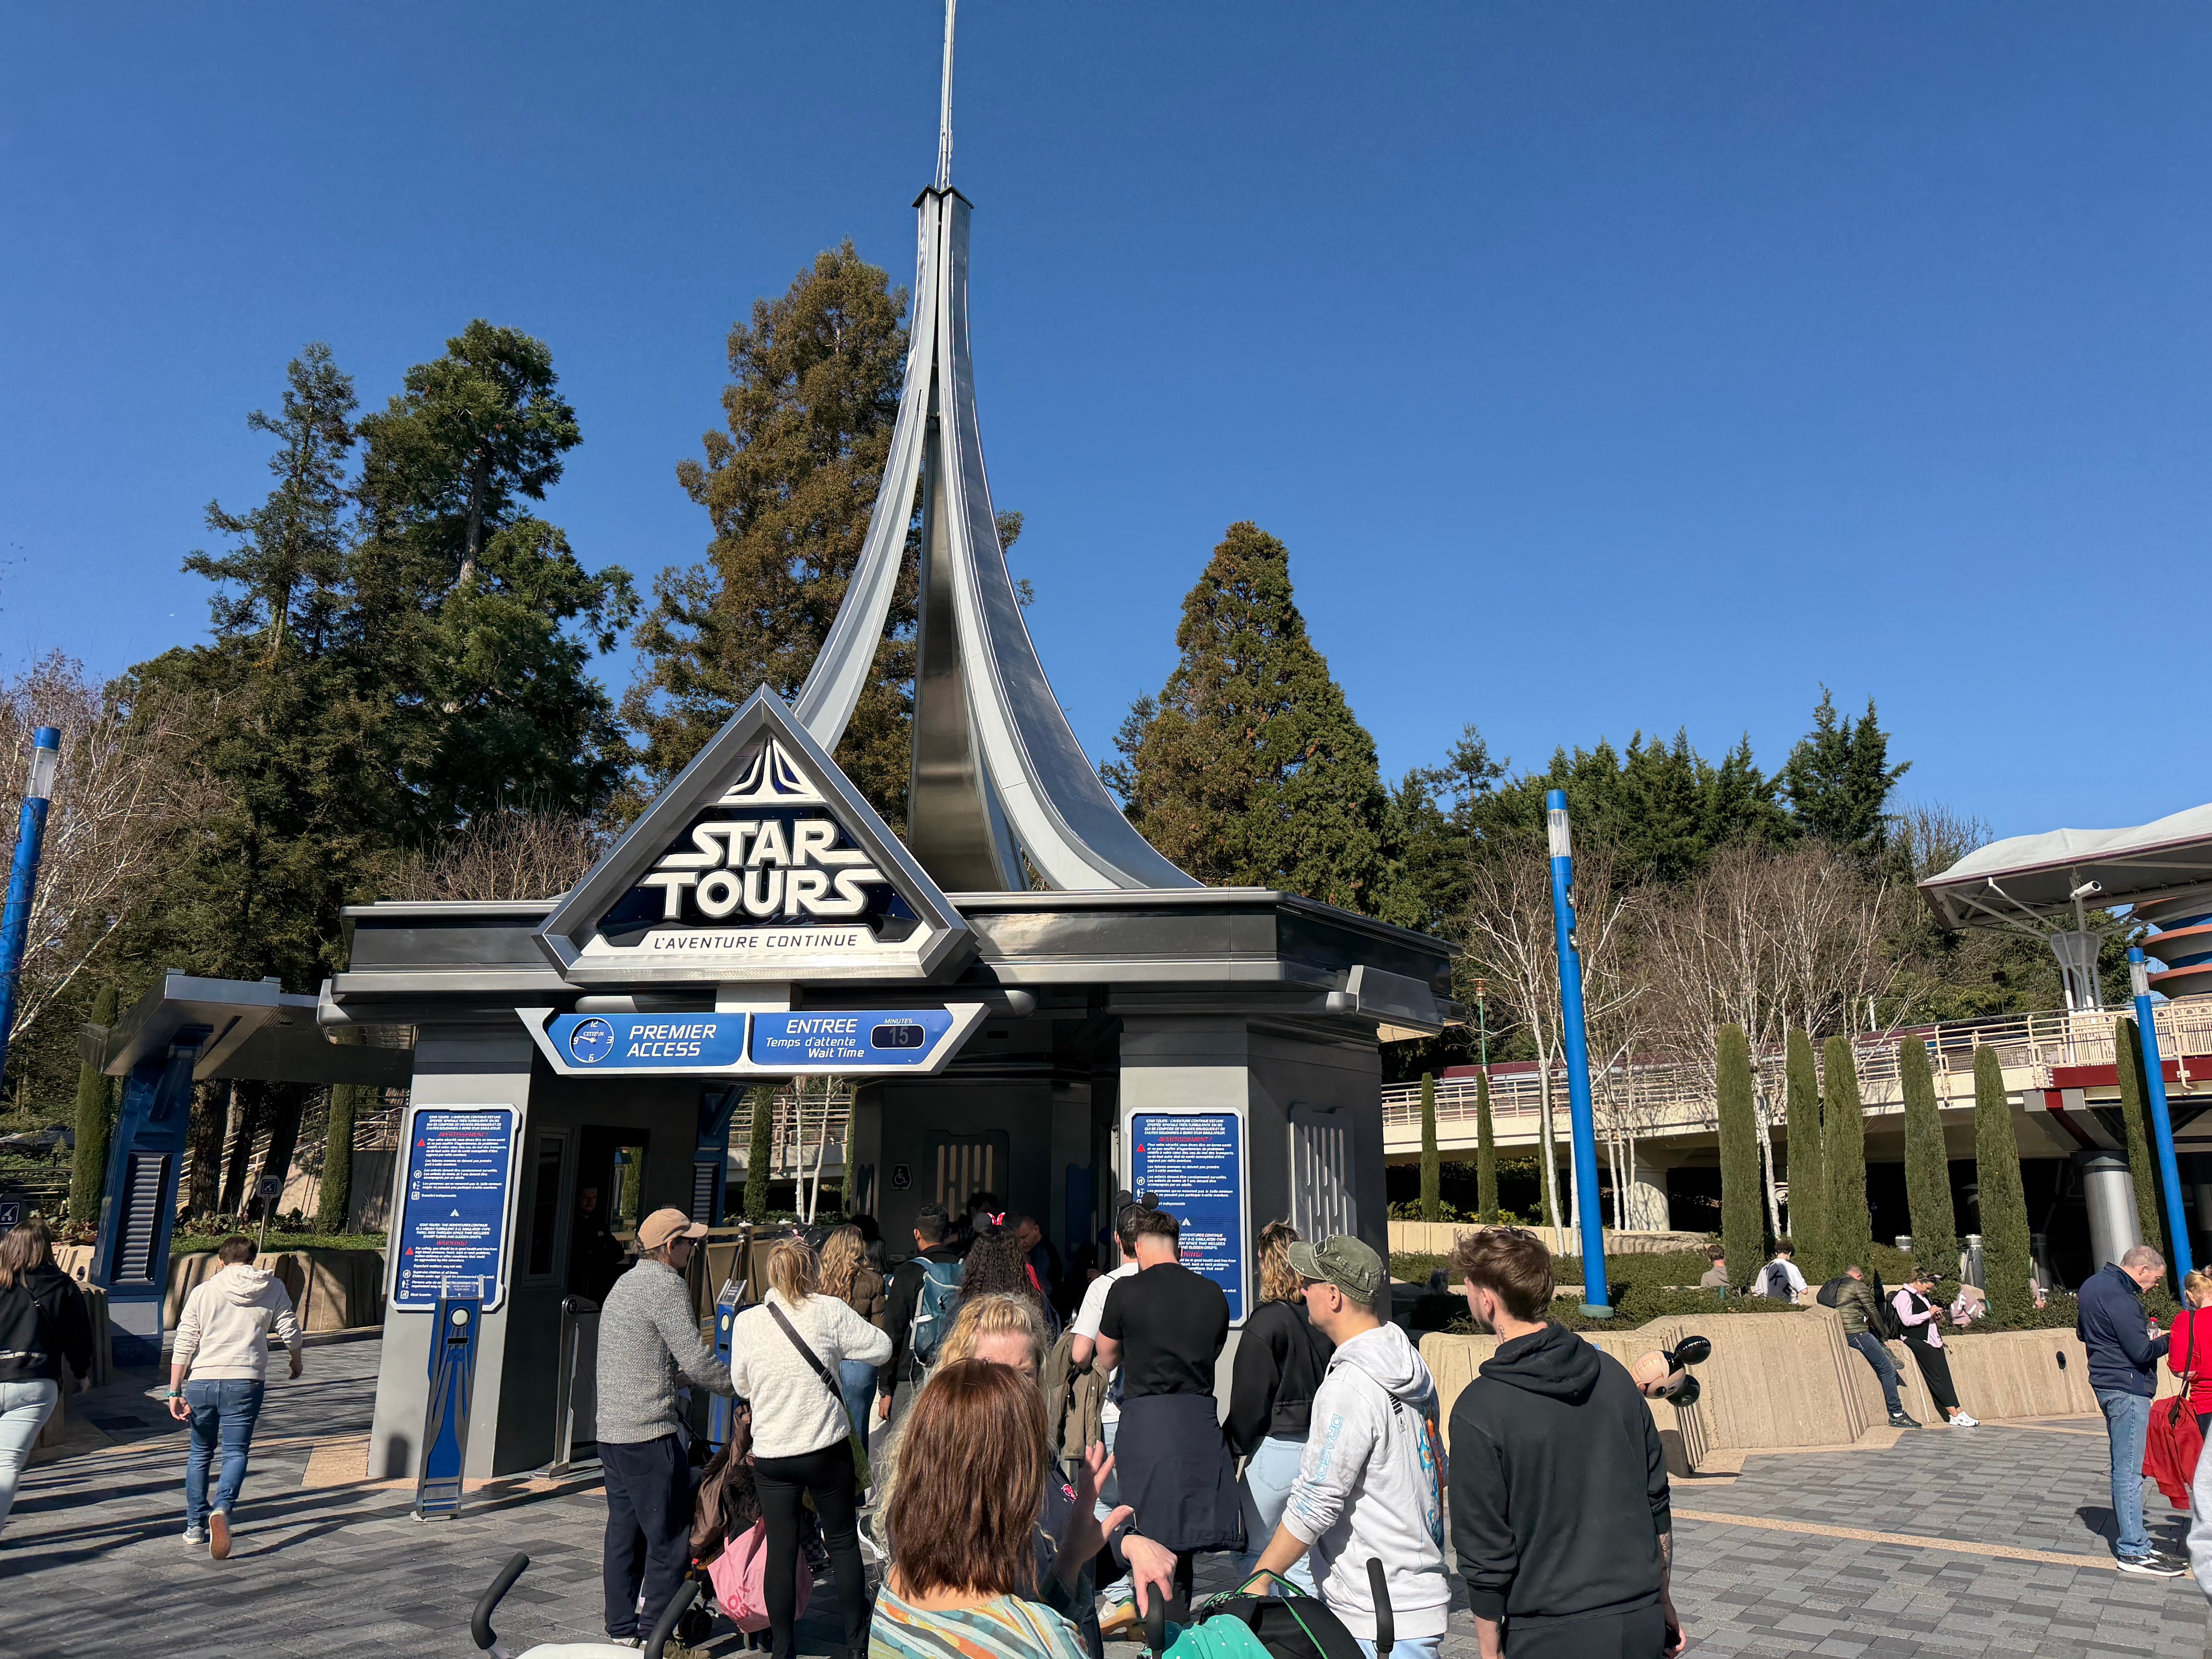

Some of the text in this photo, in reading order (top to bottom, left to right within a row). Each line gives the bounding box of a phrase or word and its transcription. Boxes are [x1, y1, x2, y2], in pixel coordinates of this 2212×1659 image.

[657, 819, 872, 867] STAR
[642, 869, 887, 918] TOURS
[654, 934, 858, 949] L'AVENTURE CONTINUE
[629, 1024, 716, 1040] PREMIER
[787, 1018, 858, 1033] ENTREE
[766, 1037, 856, 1049] Temps d'attente
[890, 1026, 909, 1045] 15
[627, 1042, 701, 1057] ACCESS
[808, 1047, 864, 1058] Wait Time
